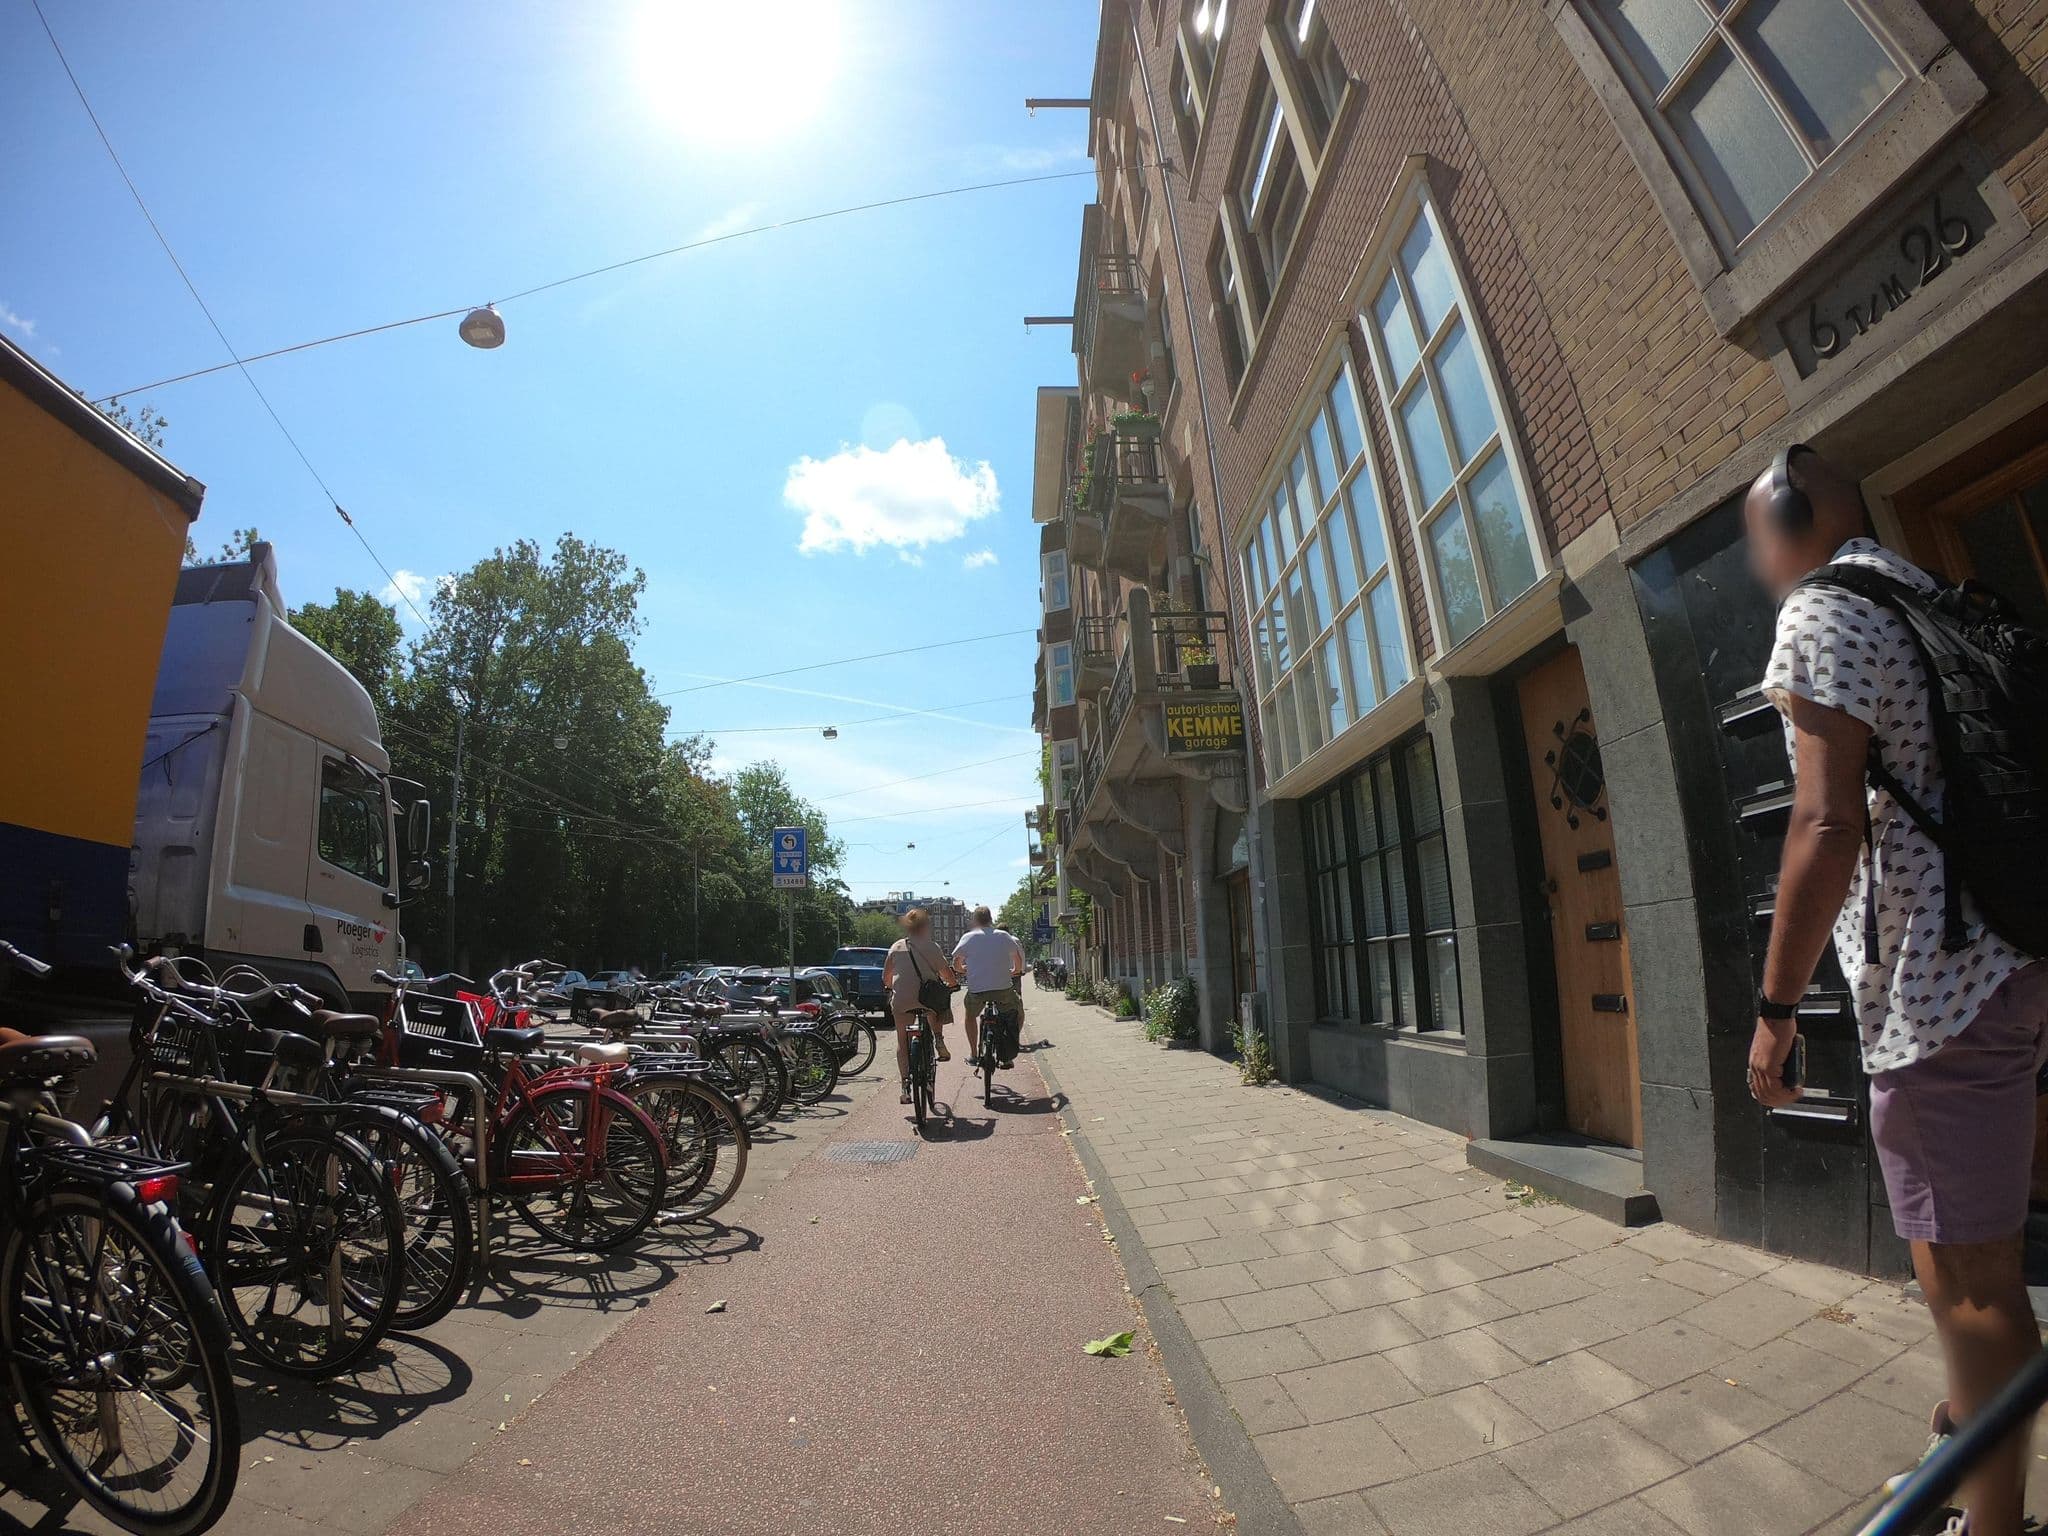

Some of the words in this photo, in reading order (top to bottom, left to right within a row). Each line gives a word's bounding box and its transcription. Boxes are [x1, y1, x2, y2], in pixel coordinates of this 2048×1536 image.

[1809, 301, 1840, 355] 6
[1900, 192, 1974, 288] 26
[1167, 702, 1240, 717] autorijschool
[1167, 715, 1242, 737] KEMME
[1185, 737, 1228, 750] garage
[337, 919, 371, 941] Ploeger
[352, 943, 379, 958] Logistics
